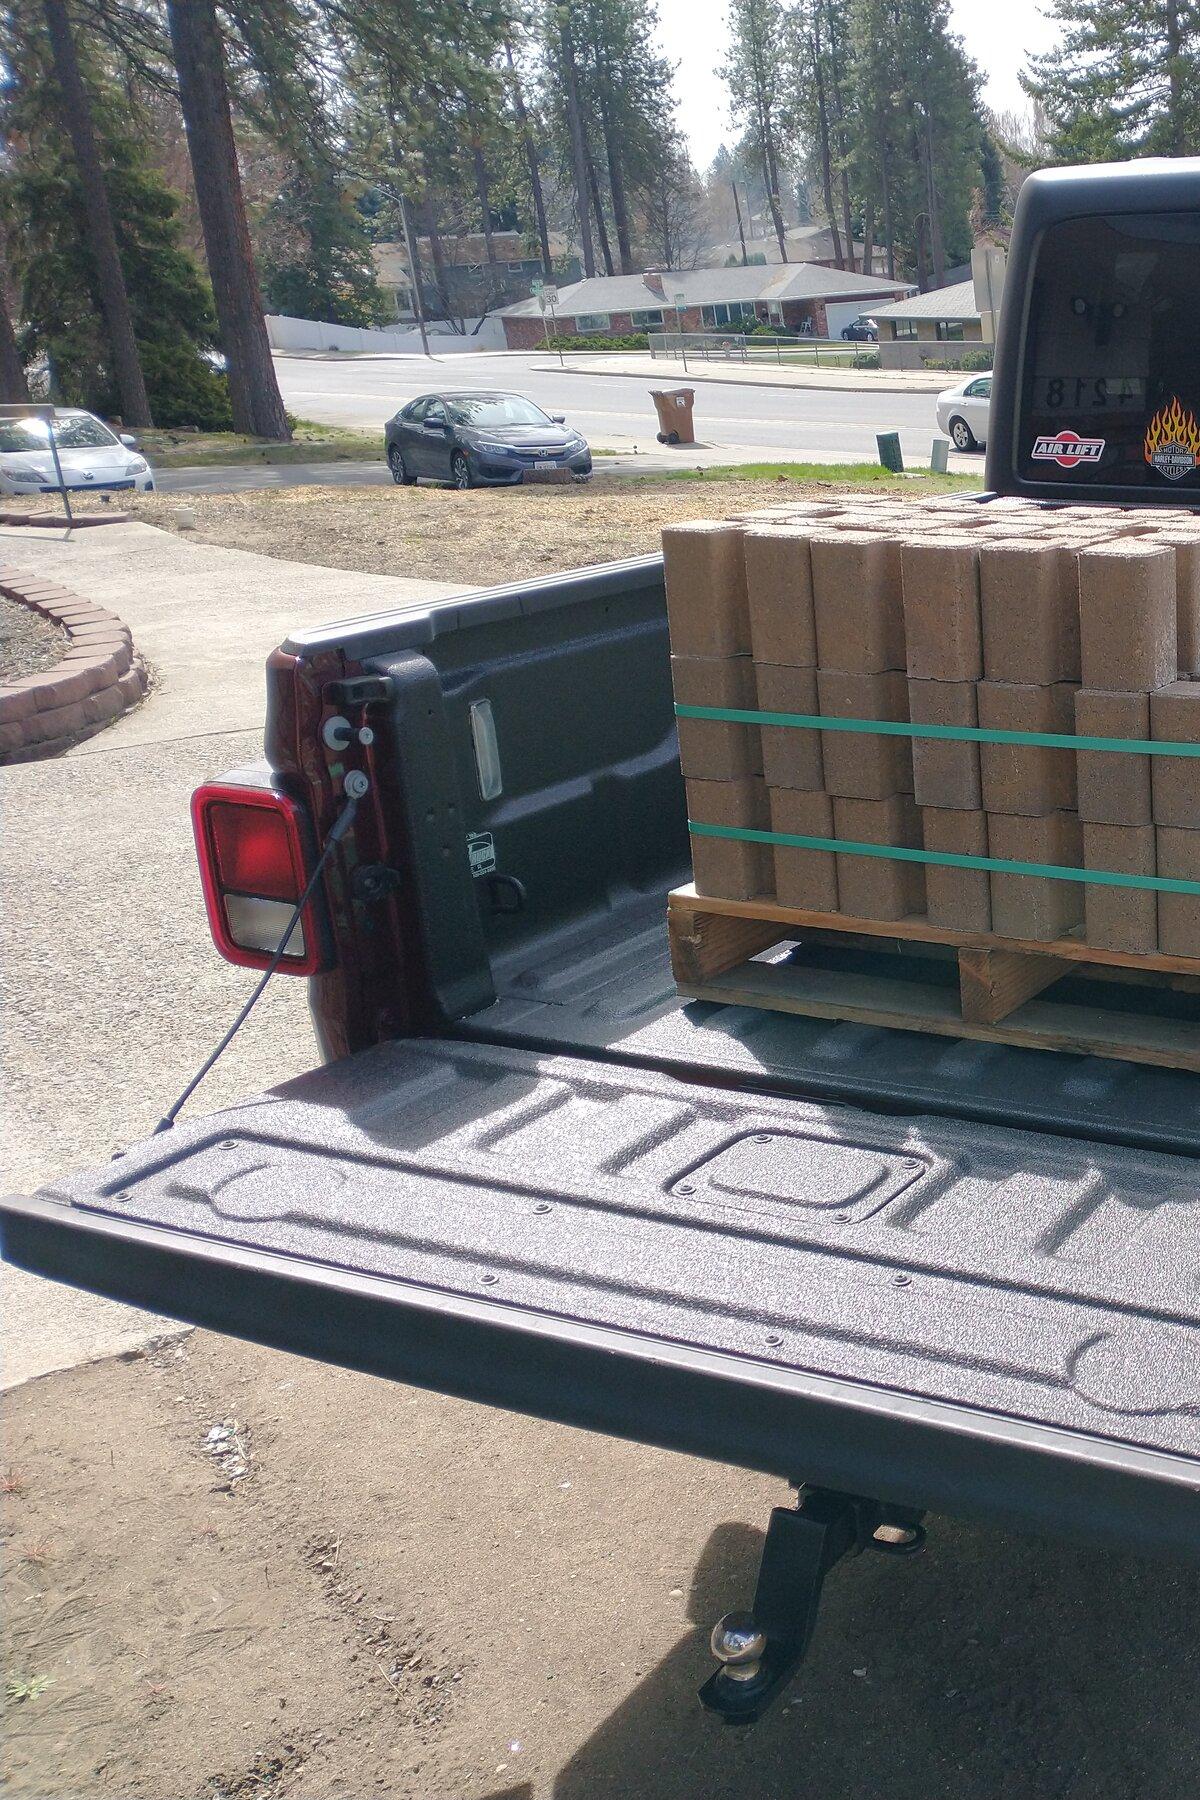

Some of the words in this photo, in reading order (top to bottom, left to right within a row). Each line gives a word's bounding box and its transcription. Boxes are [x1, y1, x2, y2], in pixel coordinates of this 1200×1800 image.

[546, 295, 557, 303] 30
[1036, 443, 1063, 454] AIR
[1066, 445, 1100, 455] LIFT
